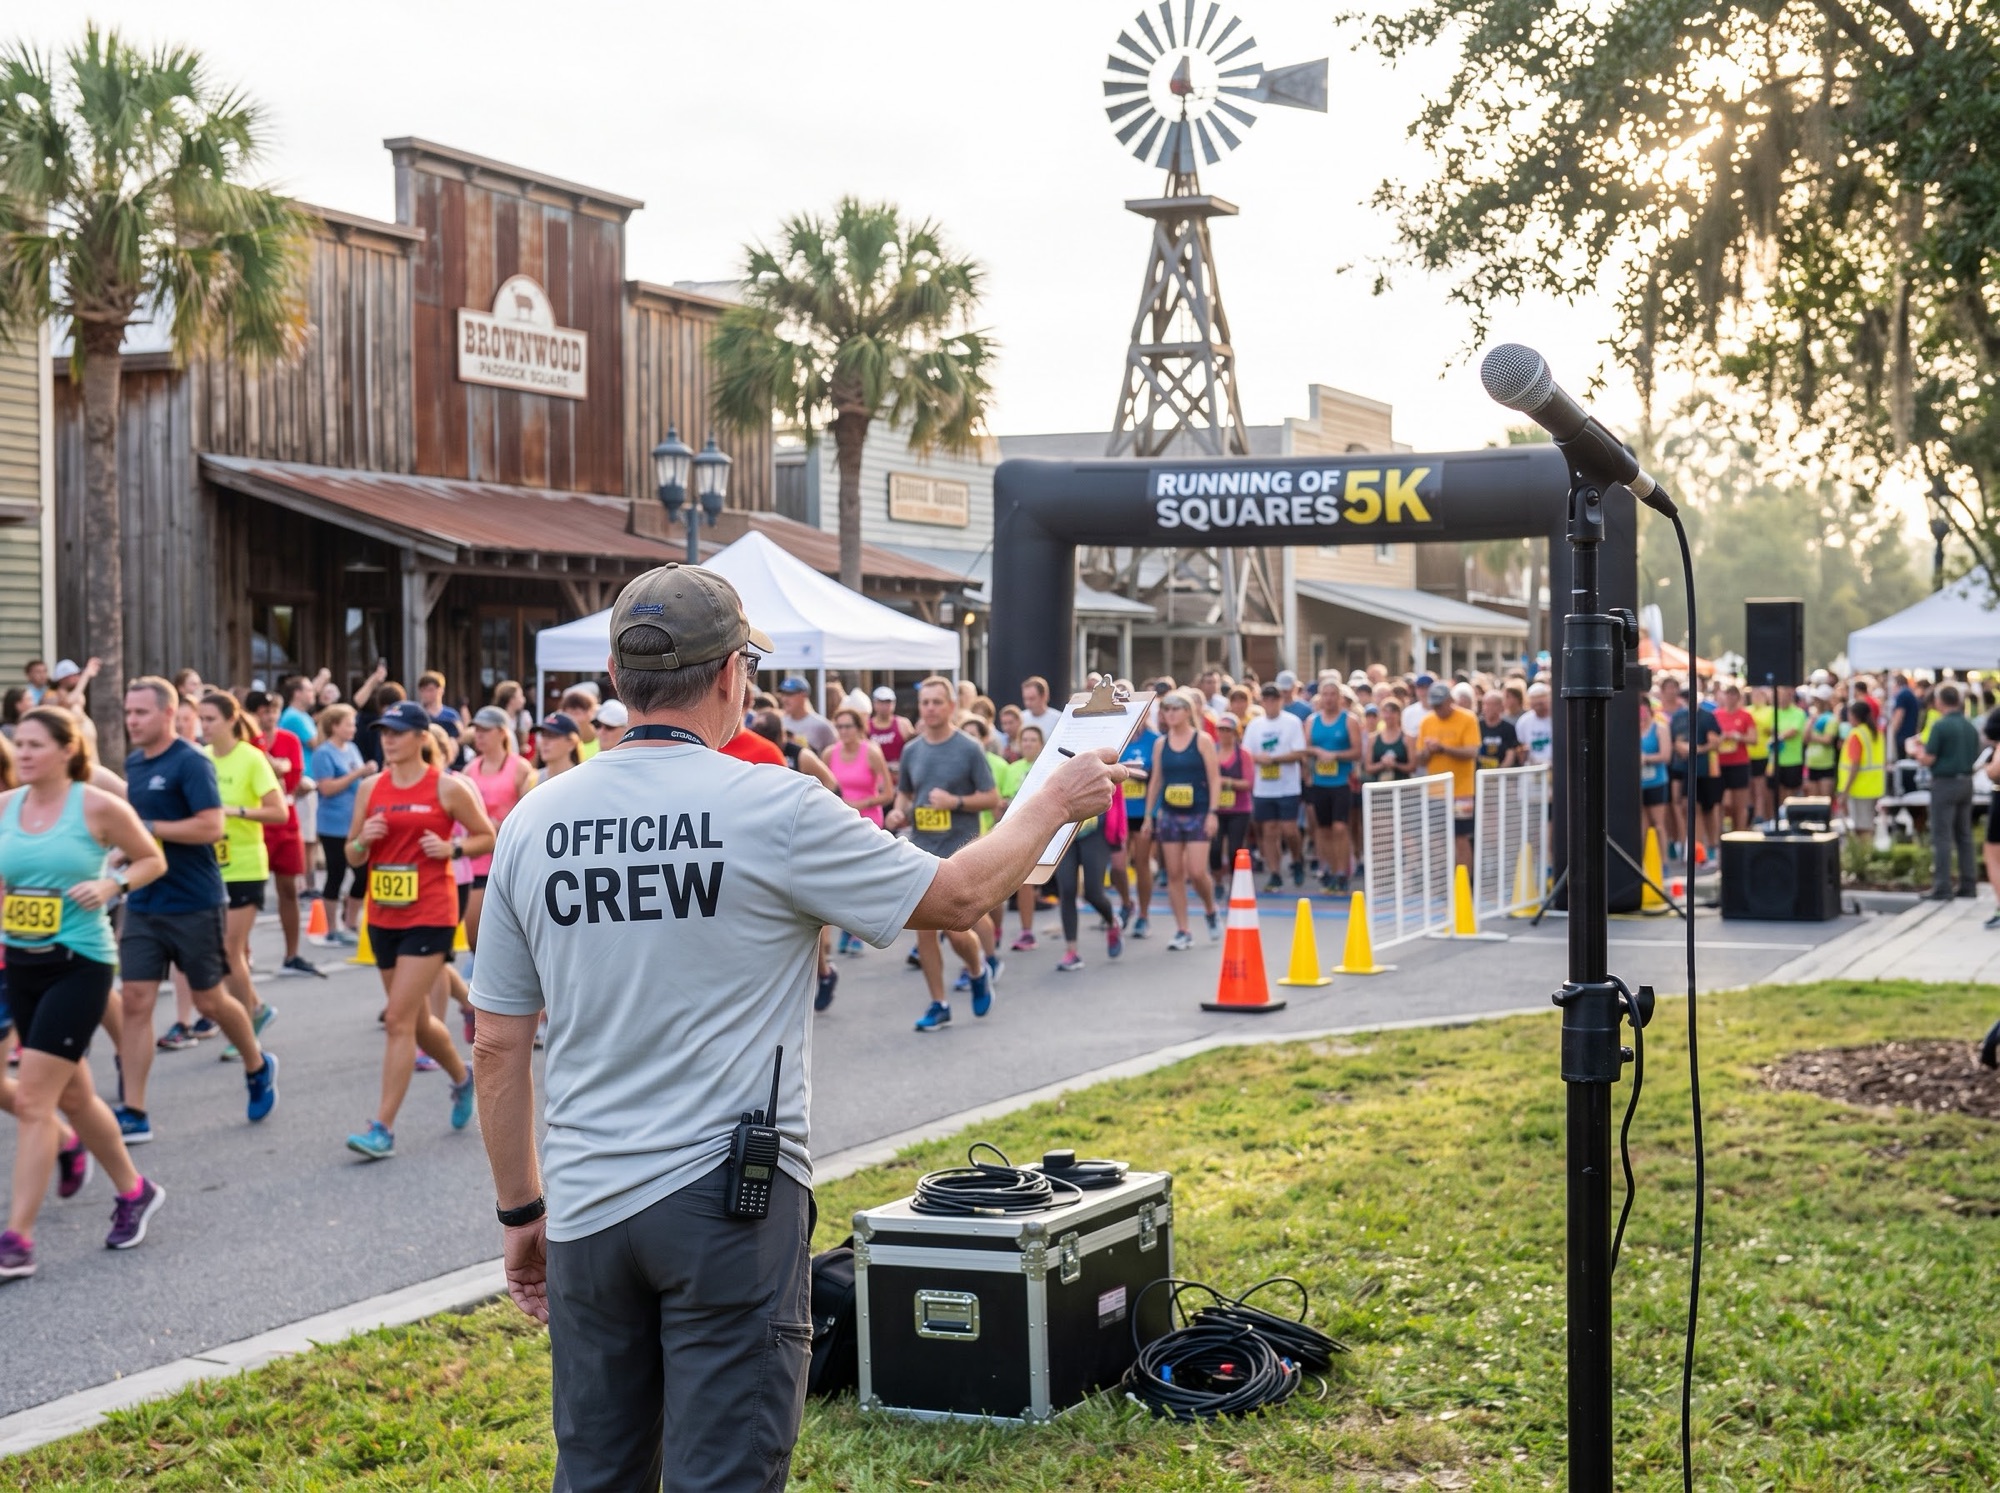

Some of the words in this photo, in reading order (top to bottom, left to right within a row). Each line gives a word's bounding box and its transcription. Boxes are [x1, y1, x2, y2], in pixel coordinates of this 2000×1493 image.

[465, 320, 581, 374] BROWNWOOD
[1156, 471, 1293, 496] RUNNING
[1298, 469, 1341, 493] OF
[1343, 466, 1433, 525] 5K
[1156, 495, 1340, 532] SQUARES
[545, 811, 723, 859] OFFICIAL
[373, 874, 413, 897] 4921
[544, 861, 725, 927] CREW
[5, 899, 56, 928] 4893
